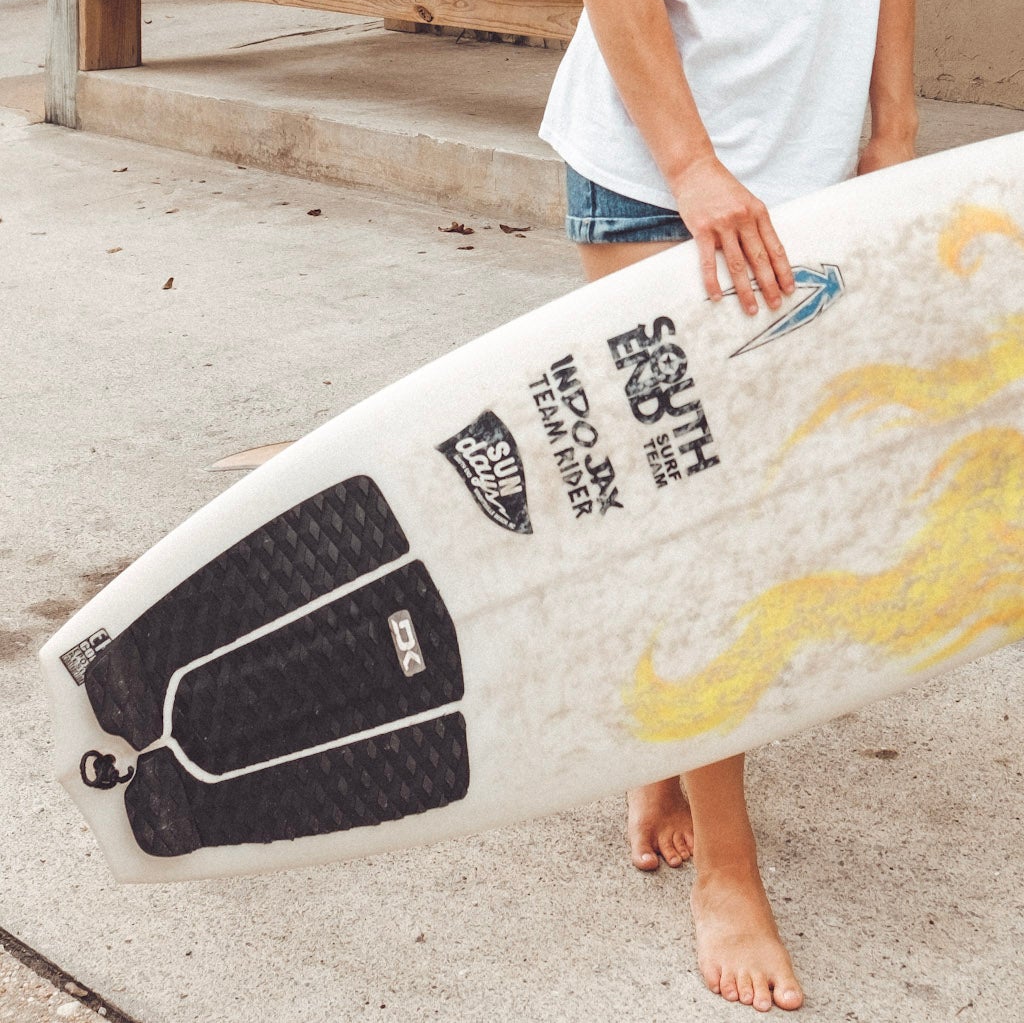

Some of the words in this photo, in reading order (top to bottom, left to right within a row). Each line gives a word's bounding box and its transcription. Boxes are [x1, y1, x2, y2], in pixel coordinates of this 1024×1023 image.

[607, 324, 668, 425] END
[652, 316, 720, 477] SOUTH
[487, 440, 523, 497] SUN
[529, 373, 567, 444] TEAM
[554, 446, 593, 519] RIDER
[550, 354, 599, 448] INDO
[584, 453, 624, 516] JAX
[643, 438, 668, 489] TEAM
[656, 433, 682, 482] SURF
